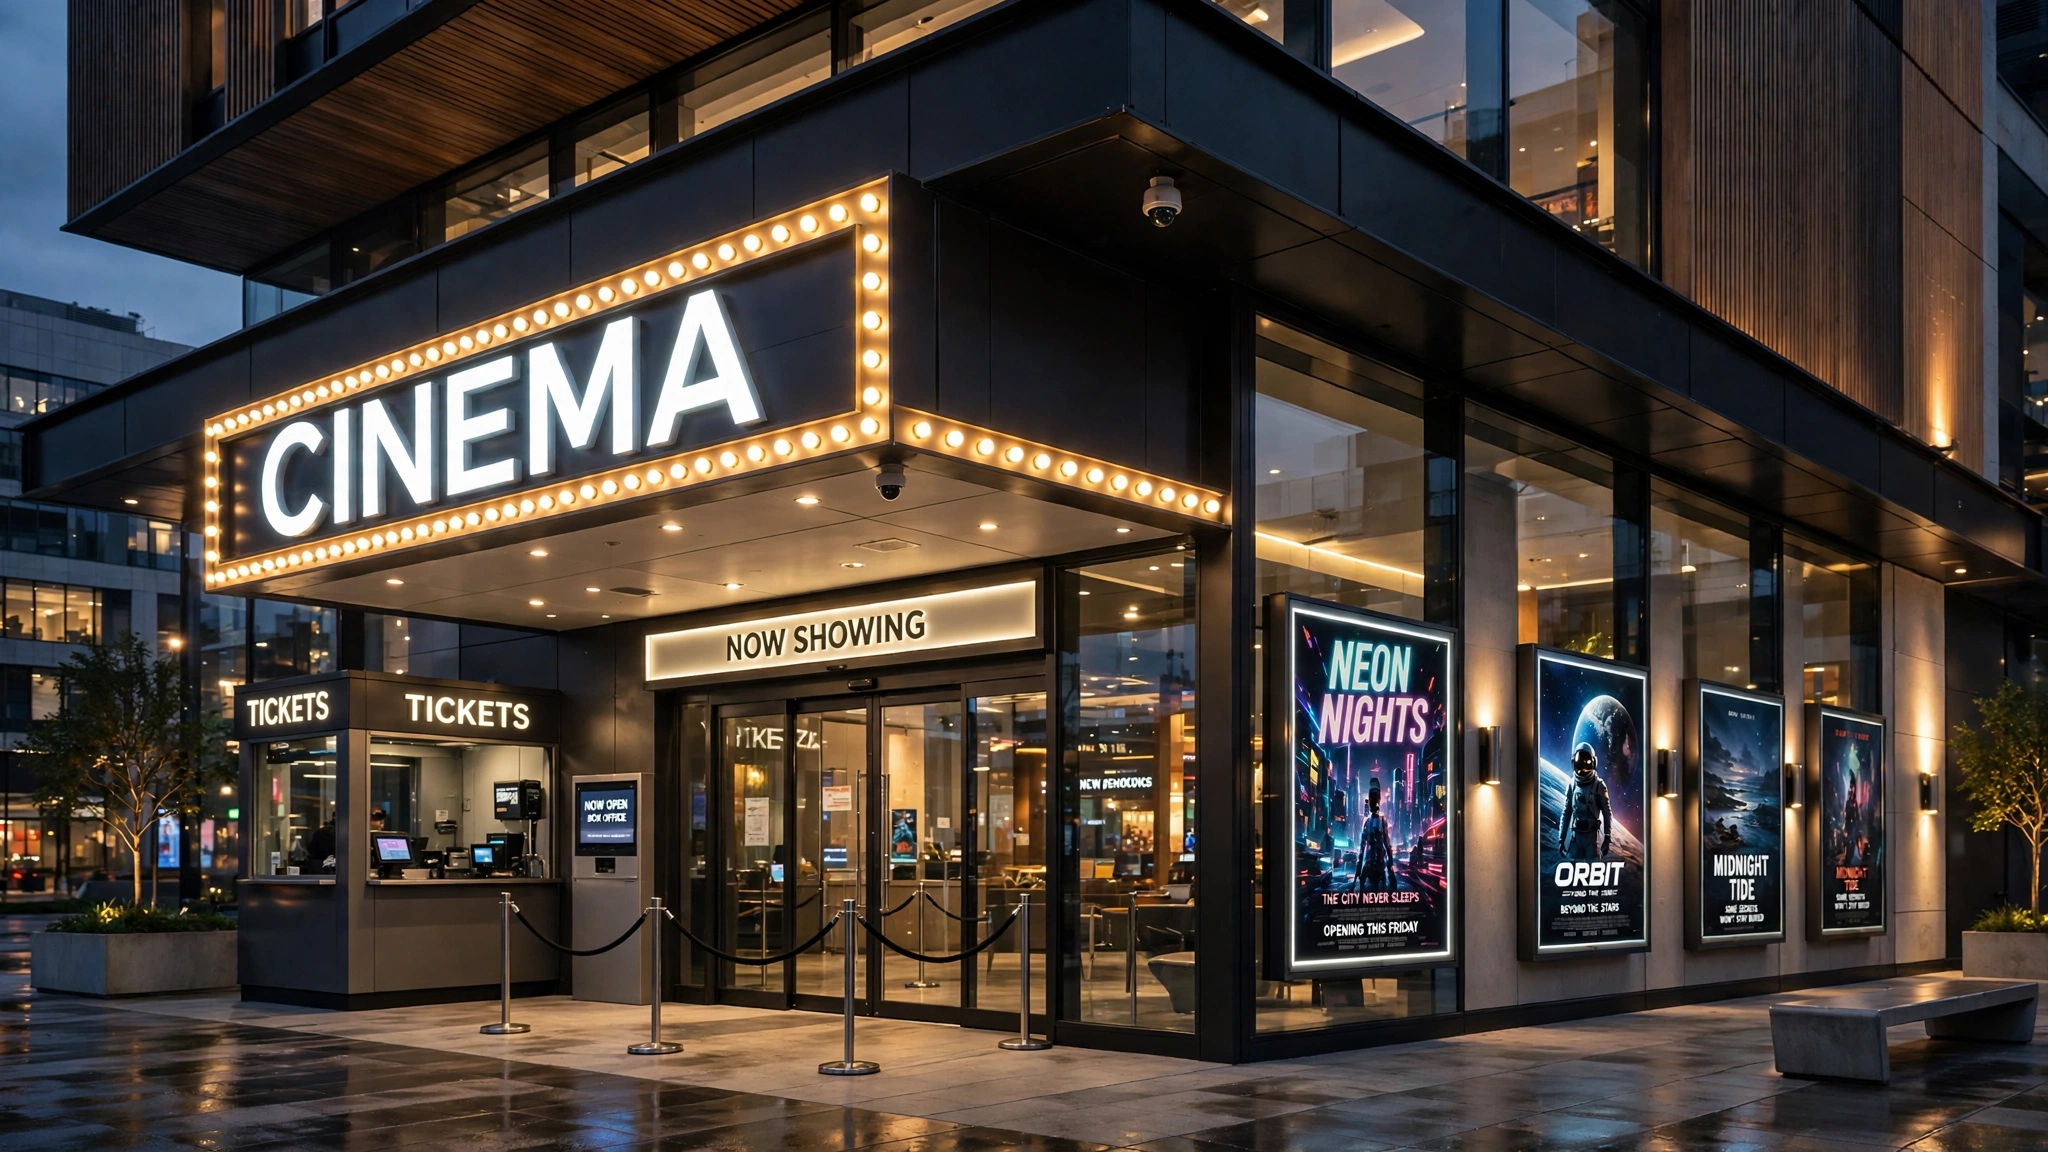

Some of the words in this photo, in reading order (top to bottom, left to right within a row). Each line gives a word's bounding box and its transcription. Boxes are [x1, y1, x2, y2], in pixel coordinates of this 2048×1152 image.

[261, 289, 765, 537] CINEMA
[727, 628, 786, 662] NOW
[794, 610, 925, 654] SHOWING
[1329, 640, 1412, 693] NEON
[247, 690, 330, 727] TICKETS
[404, 693, 530, 730] TICKETS
[1318, 693, 1429, 744] NIGHTS
[1080, 779, 1101, 791] NEW
[584, 800, 604, 811] NOW
[606, 799, 628, 810] OPEN
[1554, 861, 1625, 887] ORBIT
[1713, 854, 1769, 877] MIDNIGHT
[1322, 893, 1338, 905] THE
[1341, 893, 1360, 905] CITY
[1363, 892, 1389, 904] NEVER
[1391, 891, 1420, 903] SLEEPS
[1729, 878, 1755, 901] TIDE
[1323, 923, 1365, 937] OPENING
[1366, 921, 1387, 936] THIS
[1388, 920, 1419, 934] FRIDAY
